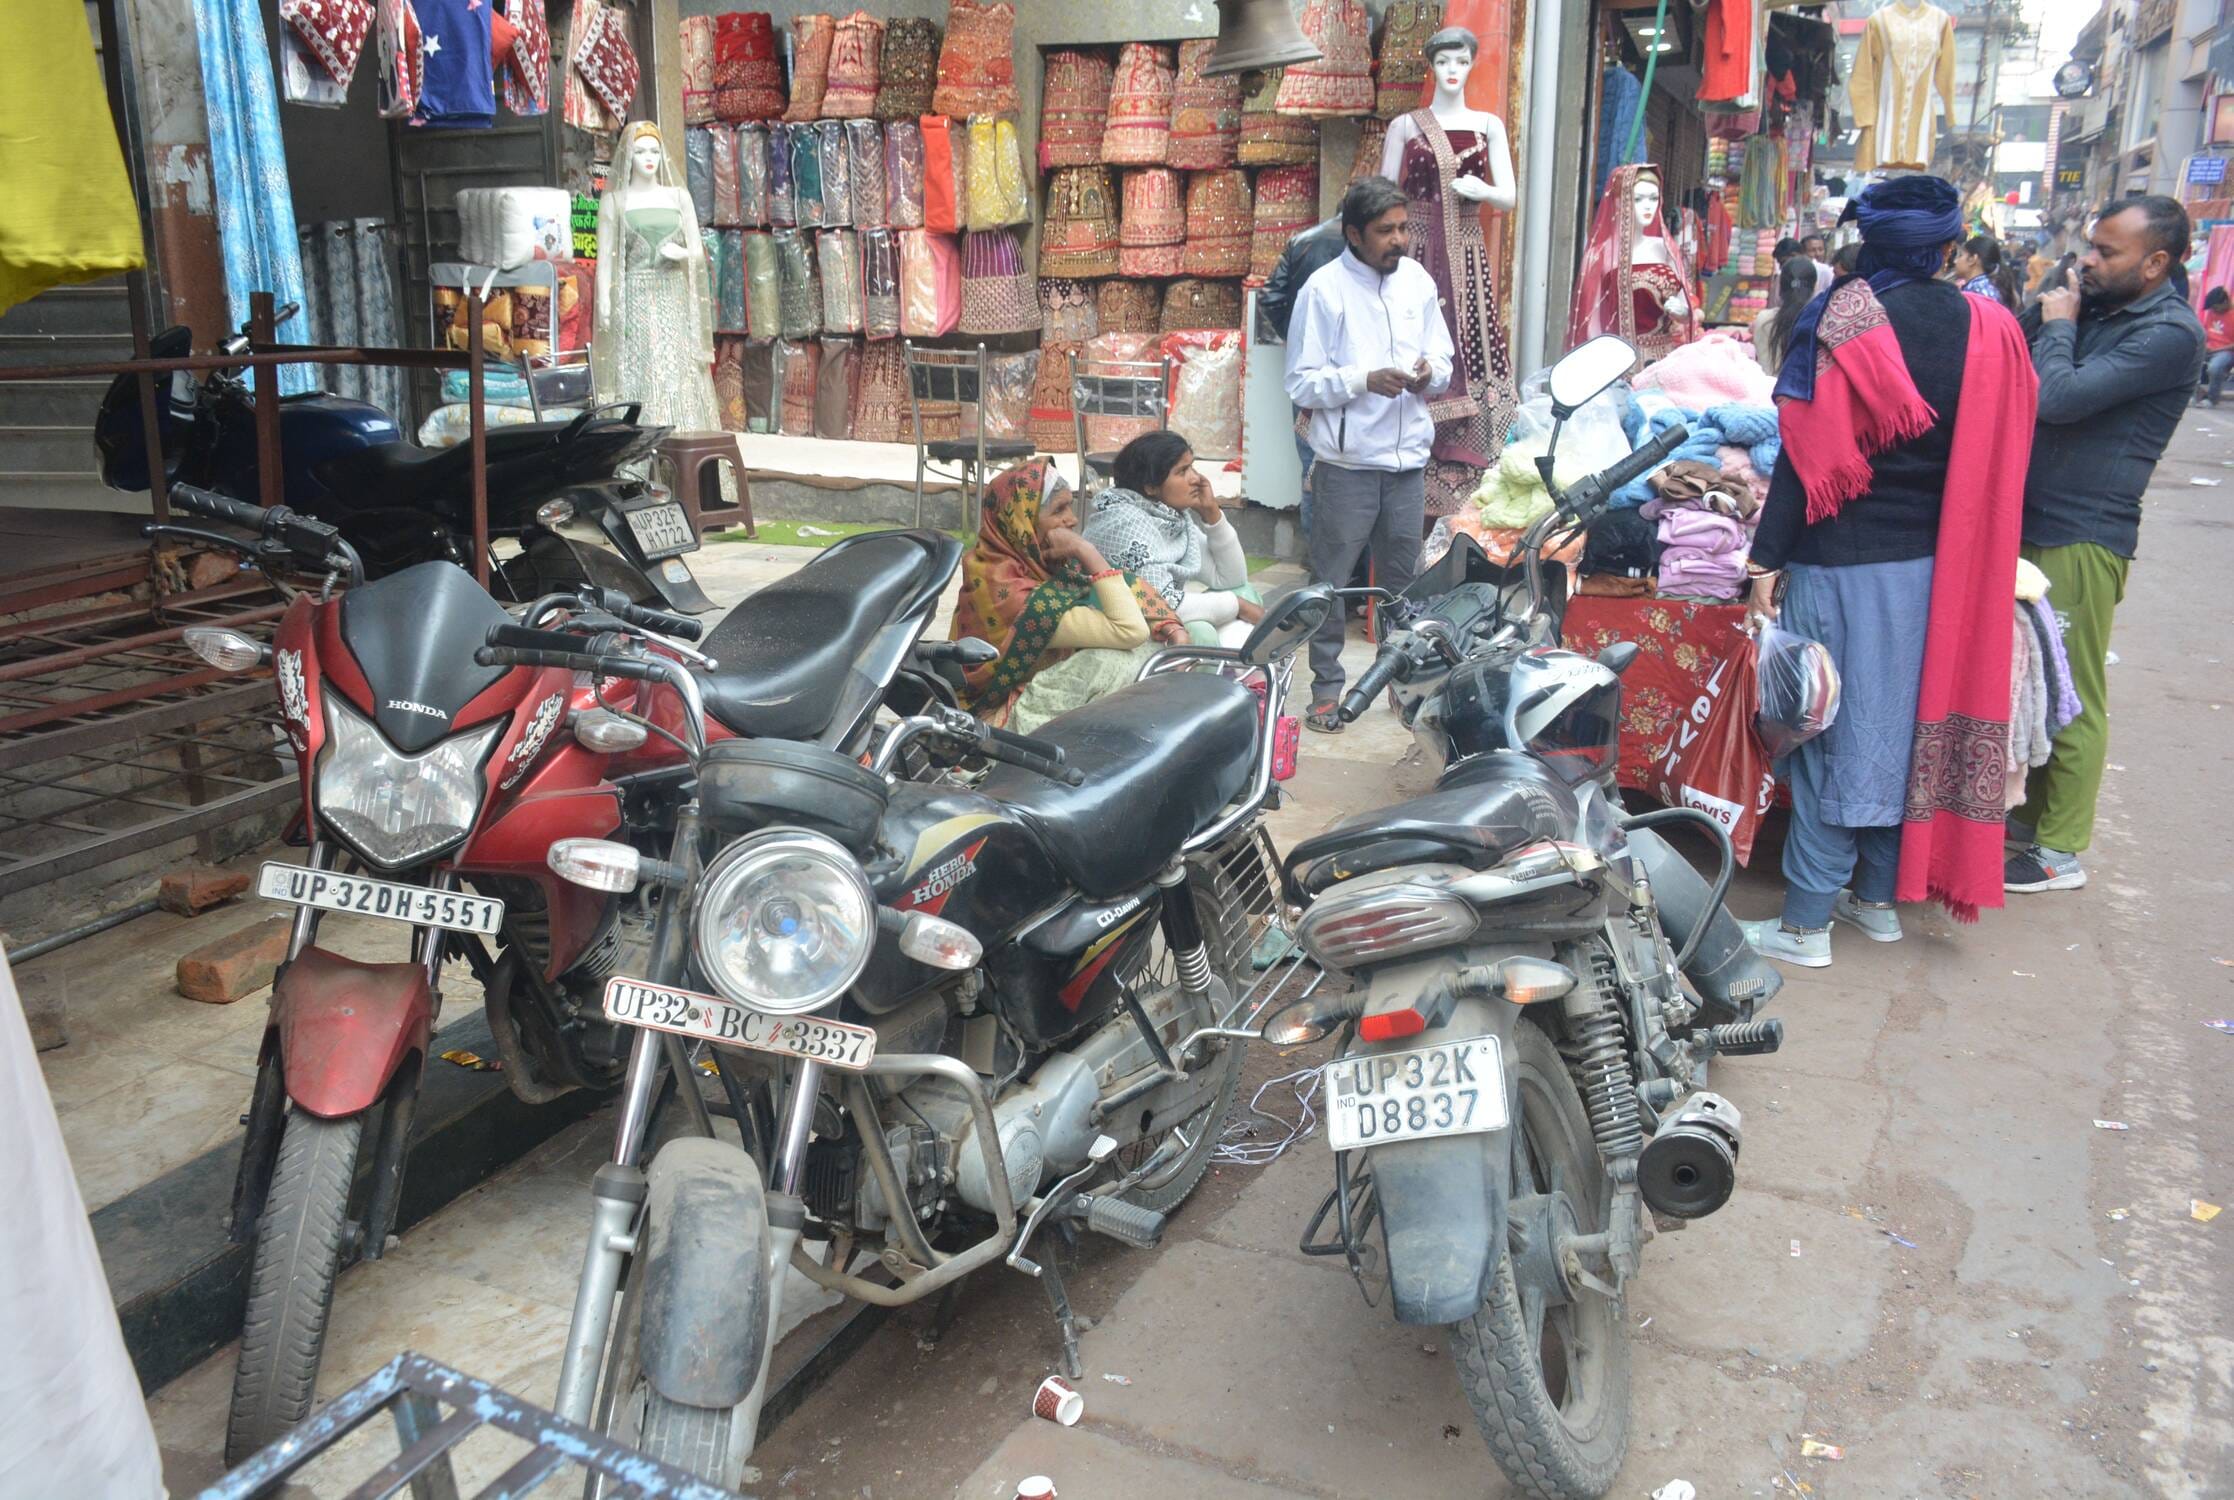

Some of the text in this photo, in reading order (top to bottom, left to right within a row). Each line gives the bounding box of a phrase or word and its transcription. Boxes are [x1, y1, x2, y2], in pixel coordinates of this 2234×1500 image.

[636, 507, 677, 530] UP32F
[645, 526, 687, 549] H1722
[386, 700, 448, 720] HONDA
[911, 859, 977, 905] HONDA
[928, 852, 966, 883] HERO
[272, 888, 288, 897] IND
[1096, 897, 1141, 928] CD-DAWN
[612, 983, 867, 1063] UP32 BC 3337
[1354, 1045, 1476, 1097] UP32K
[1337, 1097, 1356, 1110] IND
[1358, 1089, 1478, 1138] D8837
